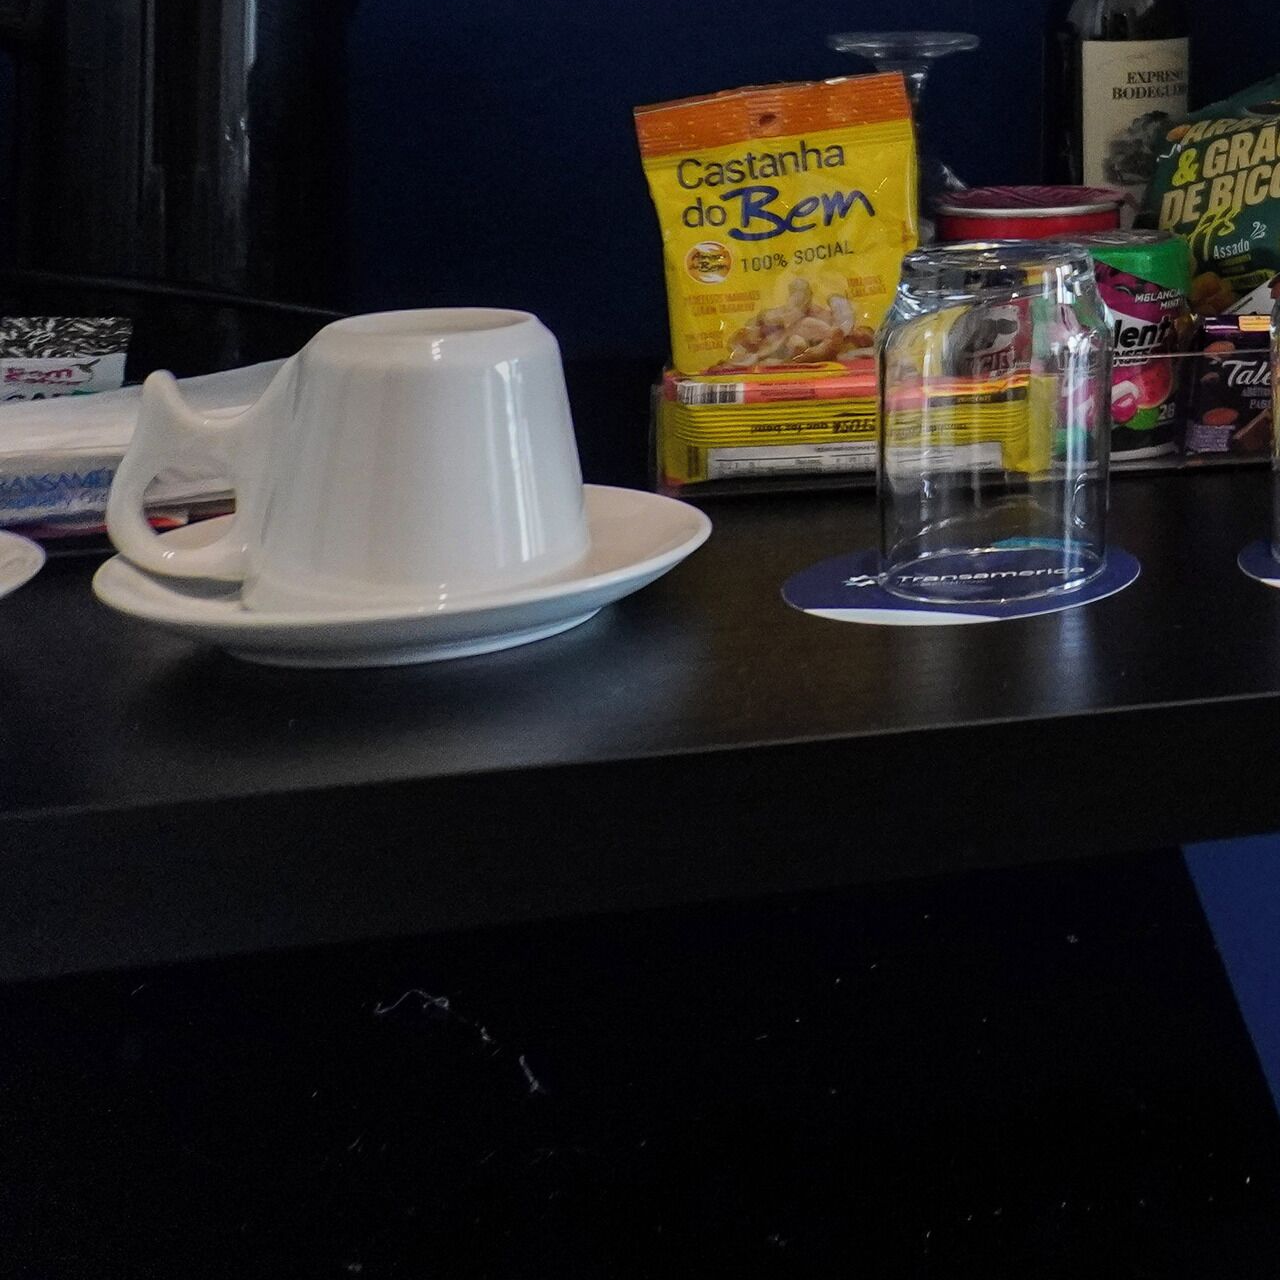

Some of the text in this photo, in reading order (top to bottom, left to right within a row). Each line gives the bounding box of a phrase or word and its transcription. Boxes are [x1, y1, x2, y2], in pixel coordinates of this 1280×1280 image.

[676, 140, 846, 190] Castanha
[1171, 148, 1200, 186] &
[682, 185, 876, 241] do Bem
[1158, 182, 1206, 230] DE
[741, 252, 789, 273] 100%
[793, 240, 854, 265] SOCIAL
[1213, 237, 1251, 260] Assado
[898, 567, 1086, 583] Transamerica
